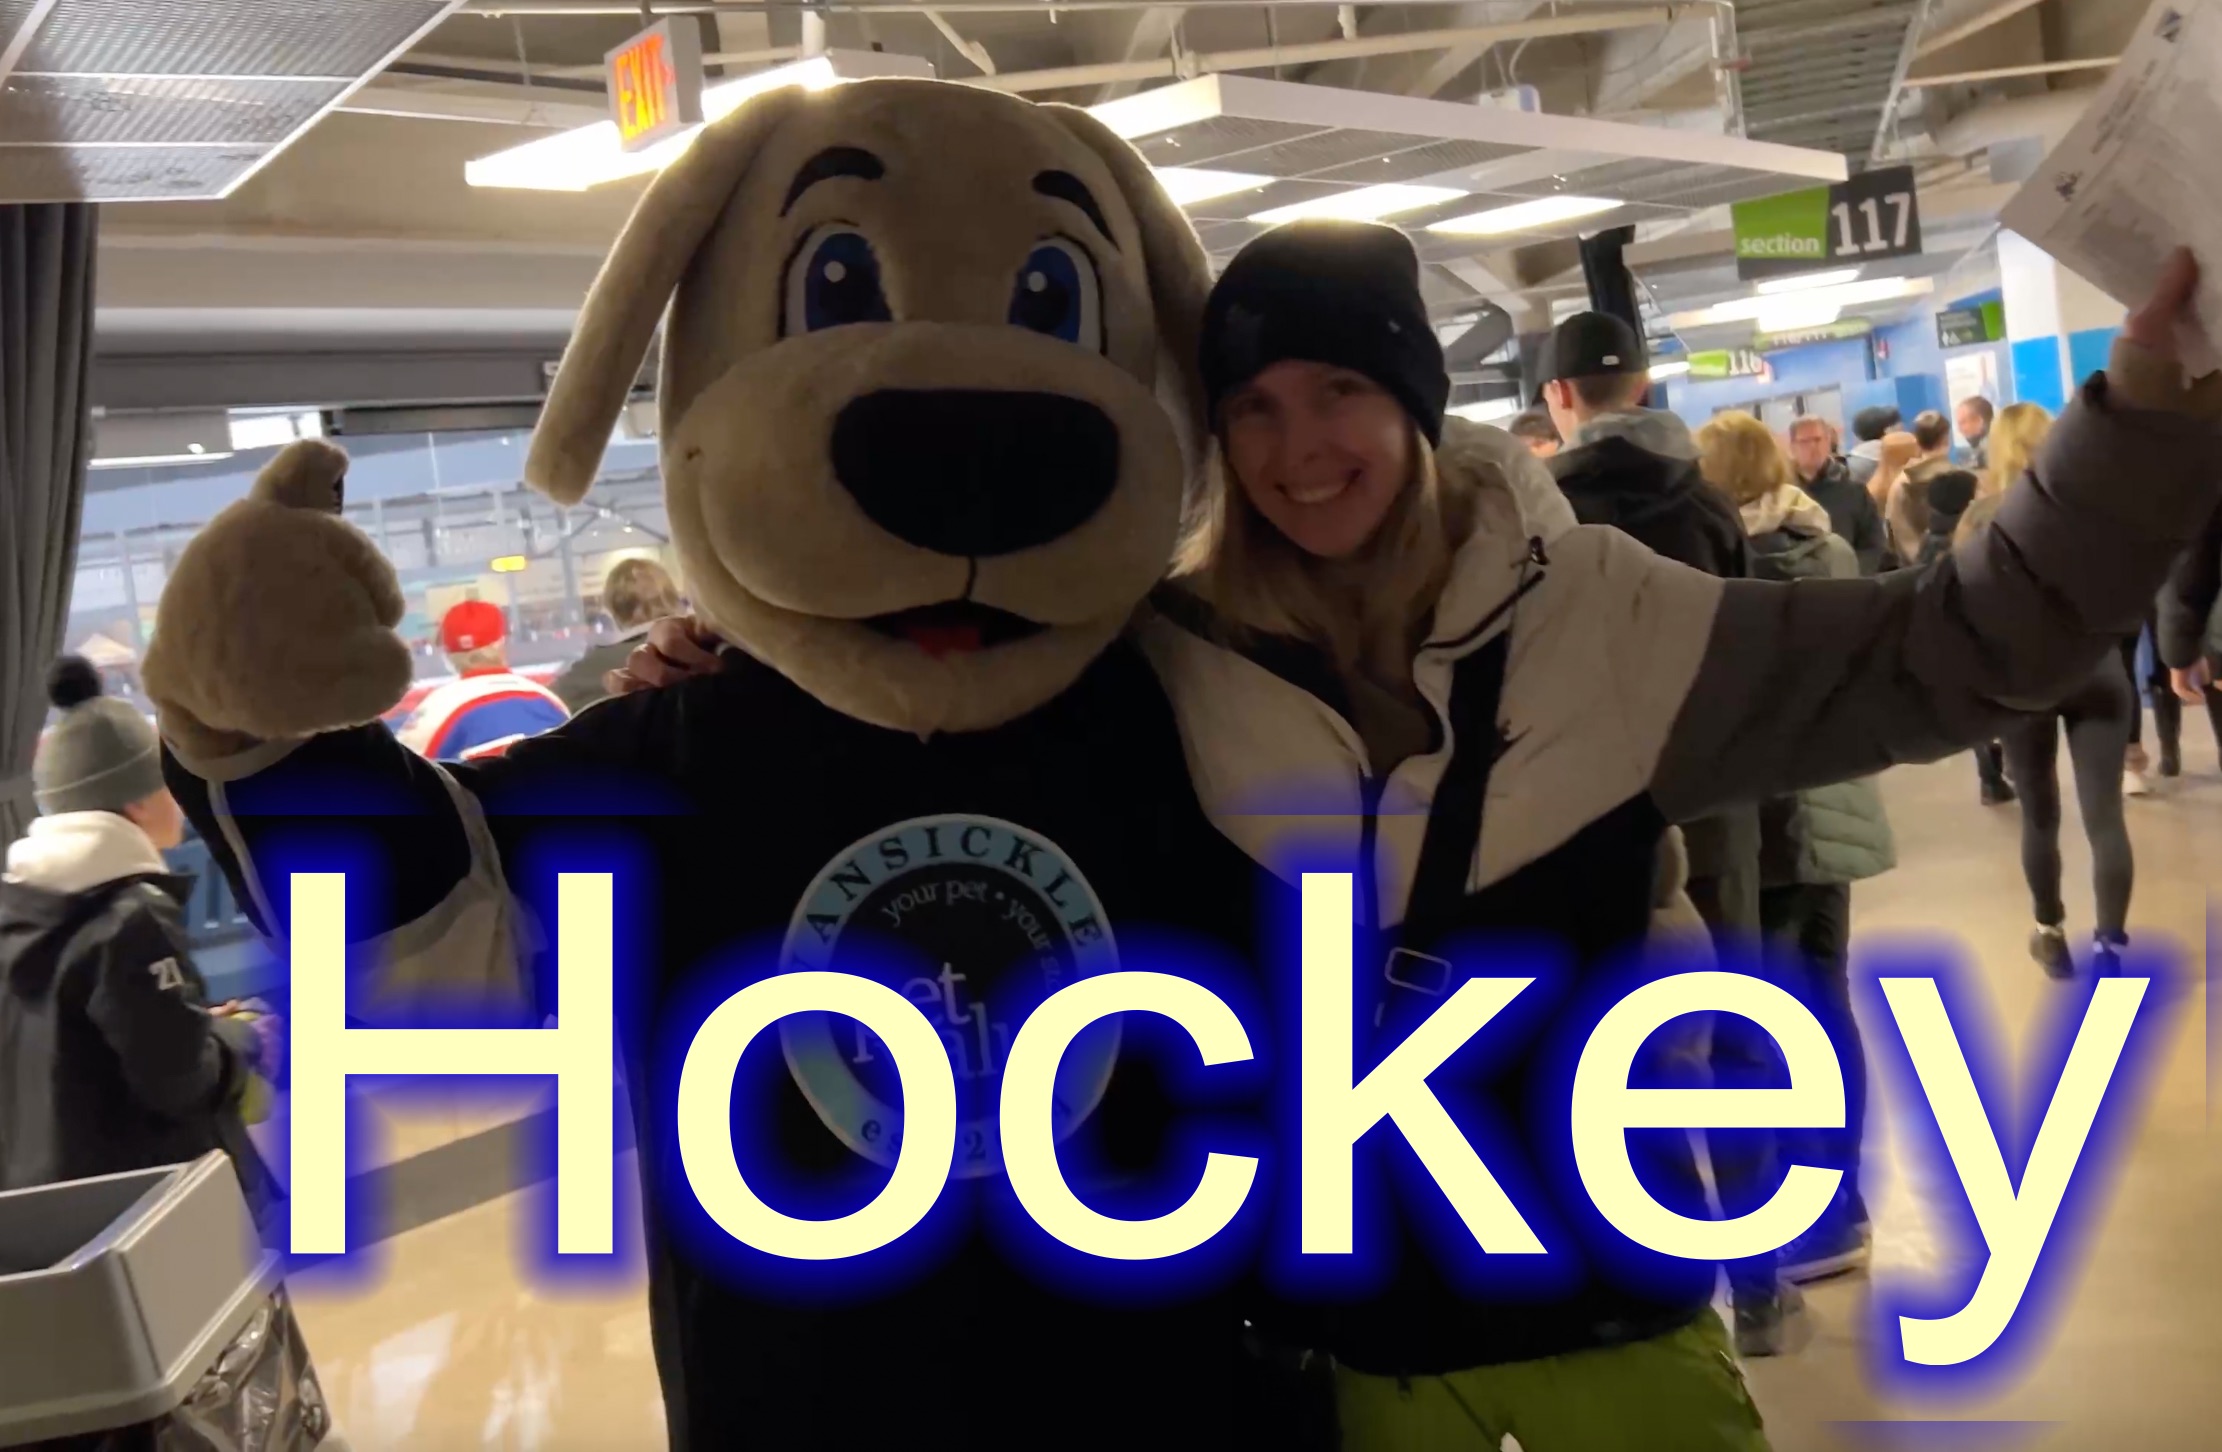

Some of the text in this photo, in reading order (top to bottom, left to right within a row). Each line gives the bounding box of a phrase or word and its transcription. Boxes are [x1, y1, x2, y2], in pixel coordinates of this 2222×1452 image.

[612, 33, 664, 141] EXIT
[1740, 191, 1911, 257] section 117
[881, 882, 939, 928] your
[946, 879, 989, 905] pet
[1000, 896, 1055, 952] your
